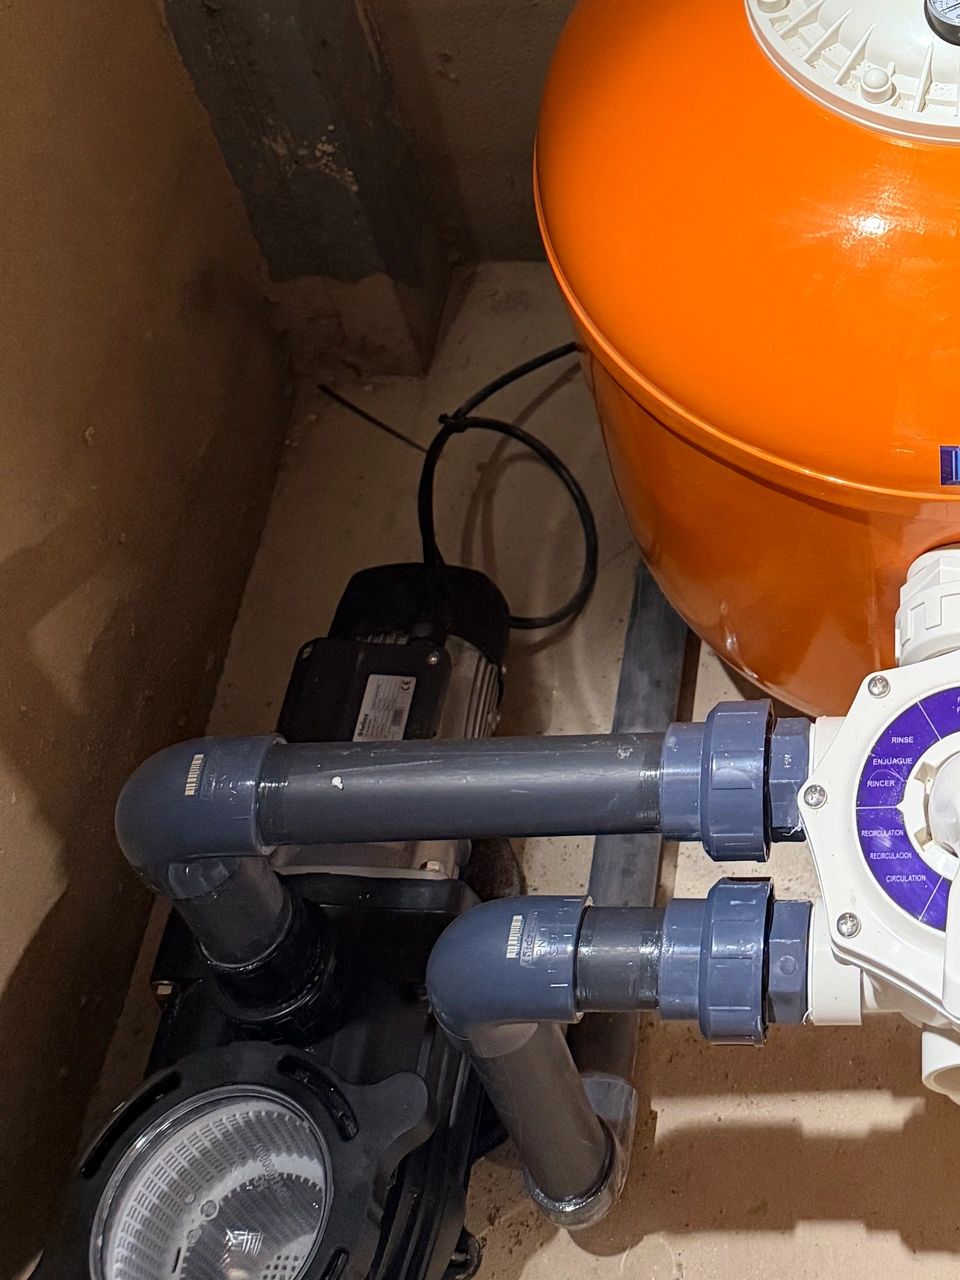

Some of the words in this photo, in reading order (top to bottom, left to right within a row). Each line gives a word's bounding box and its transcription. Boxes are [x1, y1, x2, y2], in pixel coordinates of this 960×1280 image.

[891, 736, 914, 744] RINSE
[872, 757, 913, 765] ENJUAGUE
[867, 780, 896, 788] RINCER
[861, 829, 904, 837] RECIRCULATION
[886, 874, 926, 883] CIRCULATION
